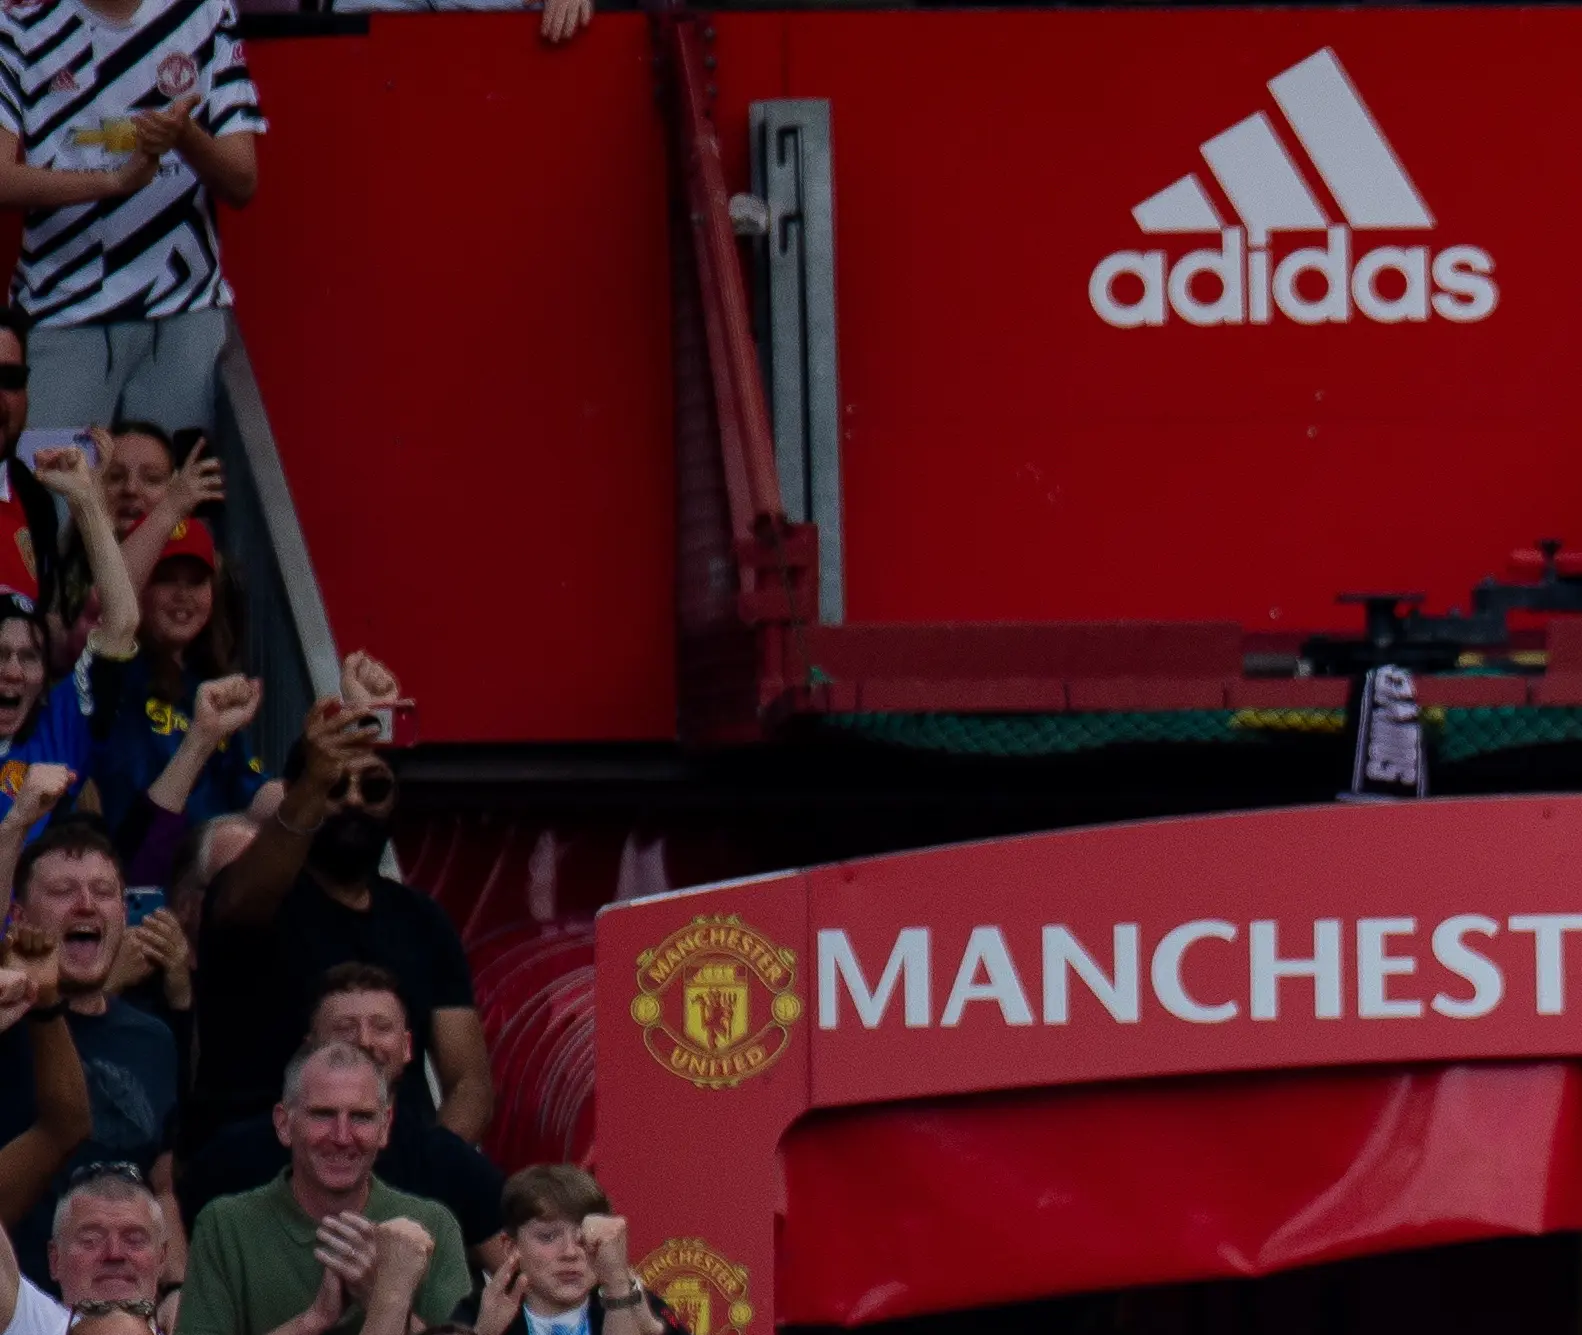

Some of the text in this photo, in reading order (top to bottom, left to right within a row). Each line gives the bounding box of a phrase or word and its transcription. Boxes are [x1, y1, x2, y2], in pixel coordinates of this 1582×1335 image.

[1089, 224, 1499, 328] adidas
[649, 927, 783, 984] MANCHESTER
[670, 1045, 766, 1076] UNITED
[639, 1250, 739, 1292] ANCHESTER
